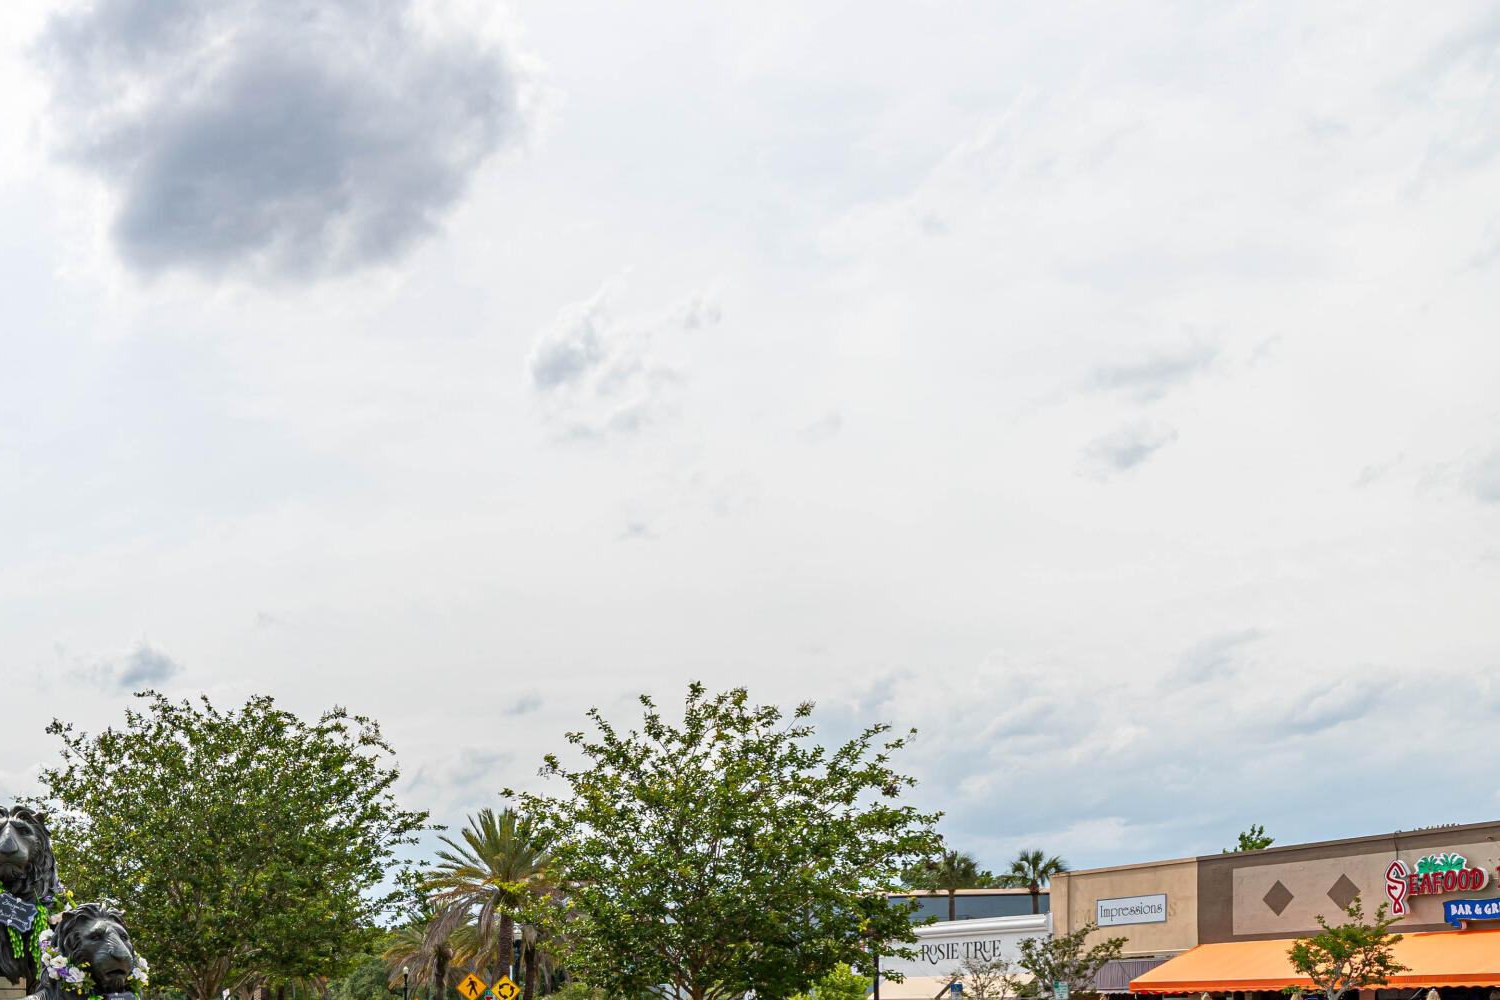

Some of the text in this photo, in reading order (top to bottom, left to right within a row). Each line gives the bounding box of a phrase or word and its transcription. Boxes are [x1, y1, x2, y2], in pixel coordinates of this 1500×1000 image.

[1385, 861, 1484, 914] SEAFOOD
[1100, 902, 1163, 921] Impressions
[1450, 904, 1472, 916] BAR
[1474, 904, 1482, 915] &
[921, 940, 1002, 965] ROSIE TRUE
